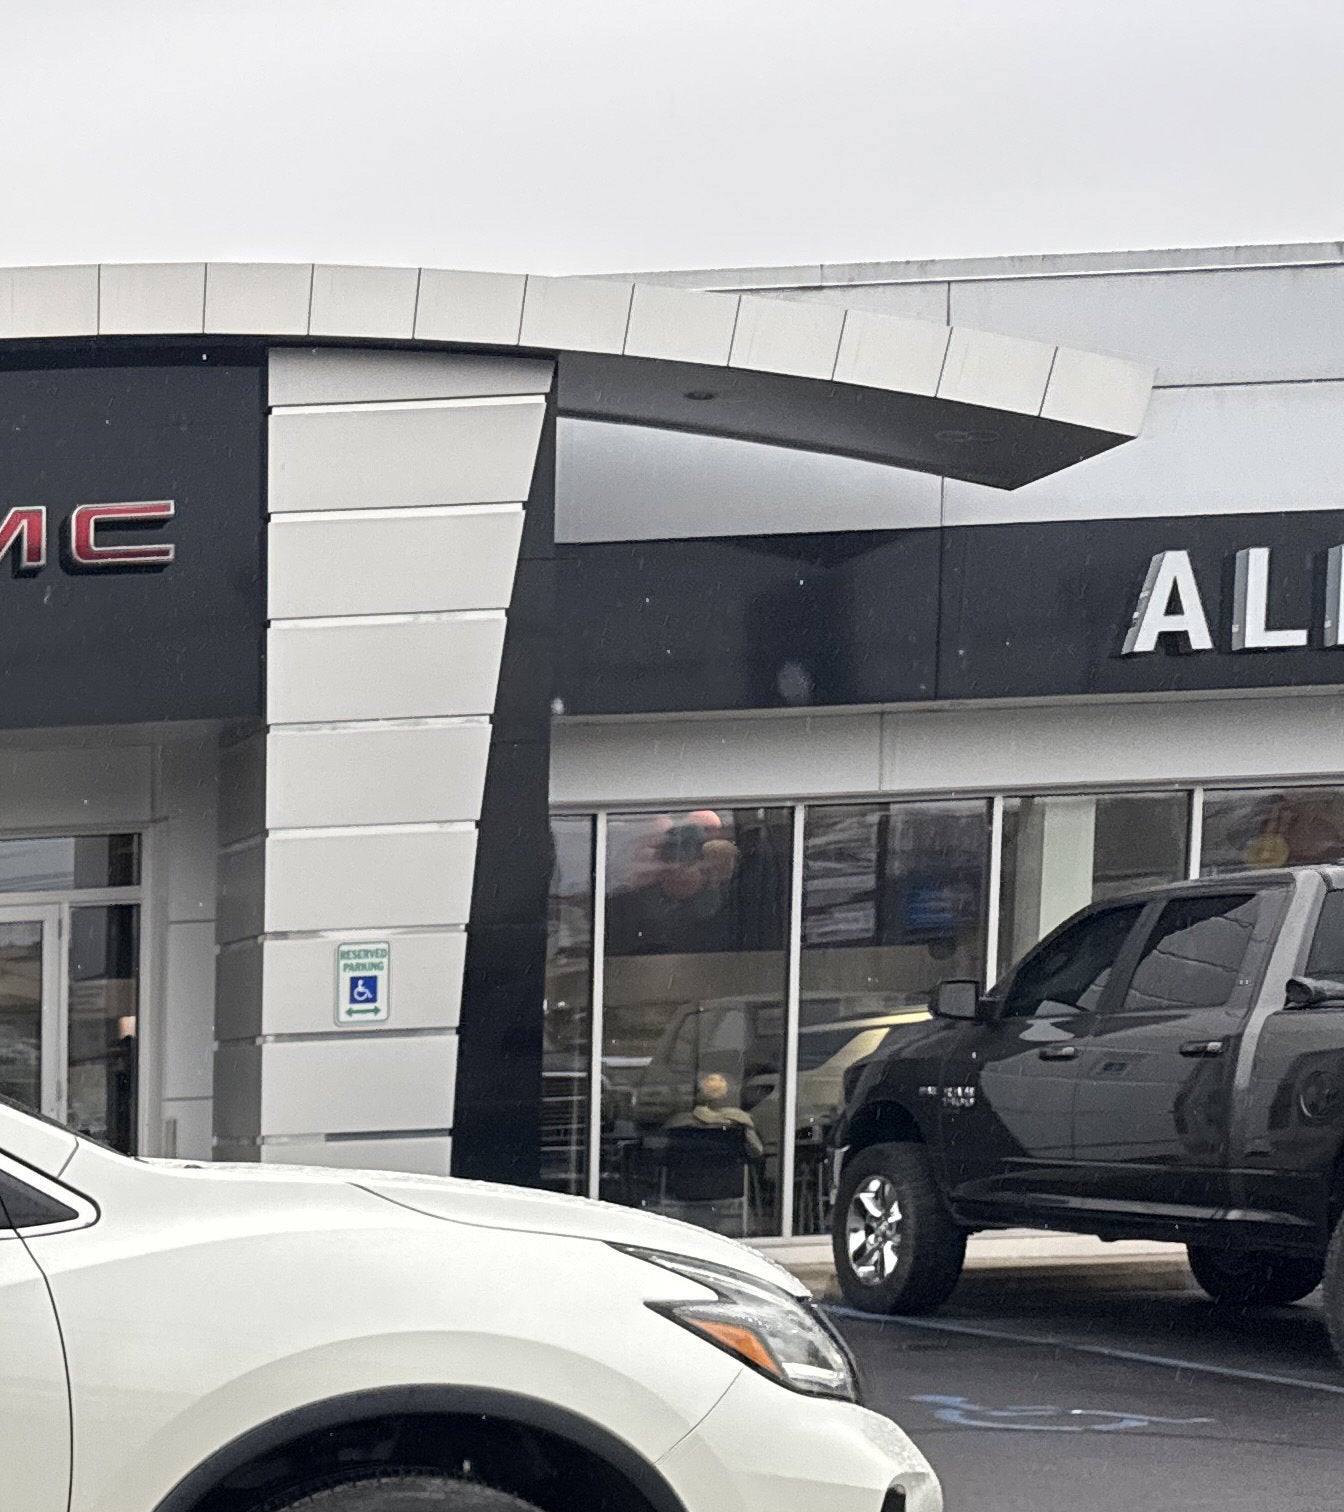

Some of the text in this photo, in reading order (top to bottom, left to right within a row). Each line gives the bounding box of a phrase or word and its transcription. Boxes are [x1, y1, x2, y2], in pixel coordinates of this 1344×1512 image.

[1122, 545, 1344, 655] AL
[340, 948, 388, 960] RESERVED
[343, 961, 384, 972] PARKING
